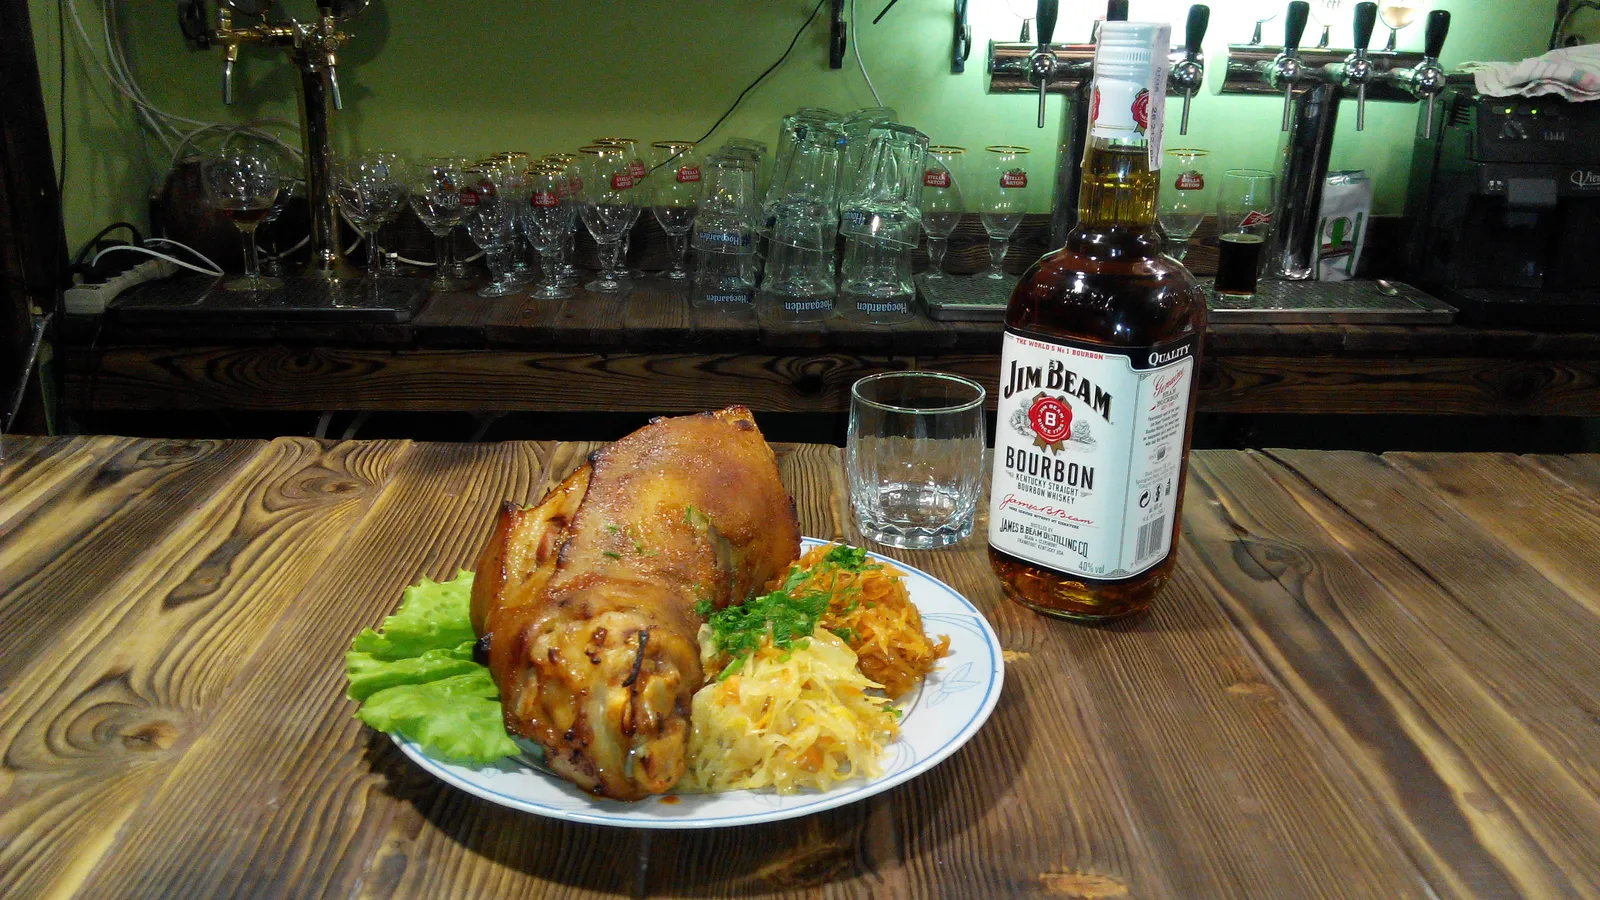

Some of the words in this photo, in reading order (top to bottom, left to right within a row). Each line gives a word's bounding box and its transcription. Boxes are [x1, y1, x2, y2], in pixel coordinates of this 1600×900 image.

[785, 299, 833, 314] Hoegaarden
[857, 301, 907, 315] Hoegaarden
[1016, 337, 1027, 345] THE
[1072, 350, 1104, 360] BOURBON
[1148, 344, 1190, 366] QUALITY
[1004, 360, 1043, 399] JIM
[1046, 359, 1114, 422] BEAM
[1045, 411, 1056, 427] B
[1006, 445, 1094, 490] BOURBON
[1016, 472, 1047, 488] KENTUCKY
[1048, 482, 1079, 497] STRAIGHT
[1017, 482, 1046, 497] BOURBON
[1047, 491, 1075, 505] WHISKEY
[1000, 517, 1019, 533] JAMES
[1025, 526, 1043, 538] BEAM
[1043, 532, 1078, 552] DISTILLING
[1079, 560, 1094, 573] 40%
[1095, 564, 1105, 574] vol
